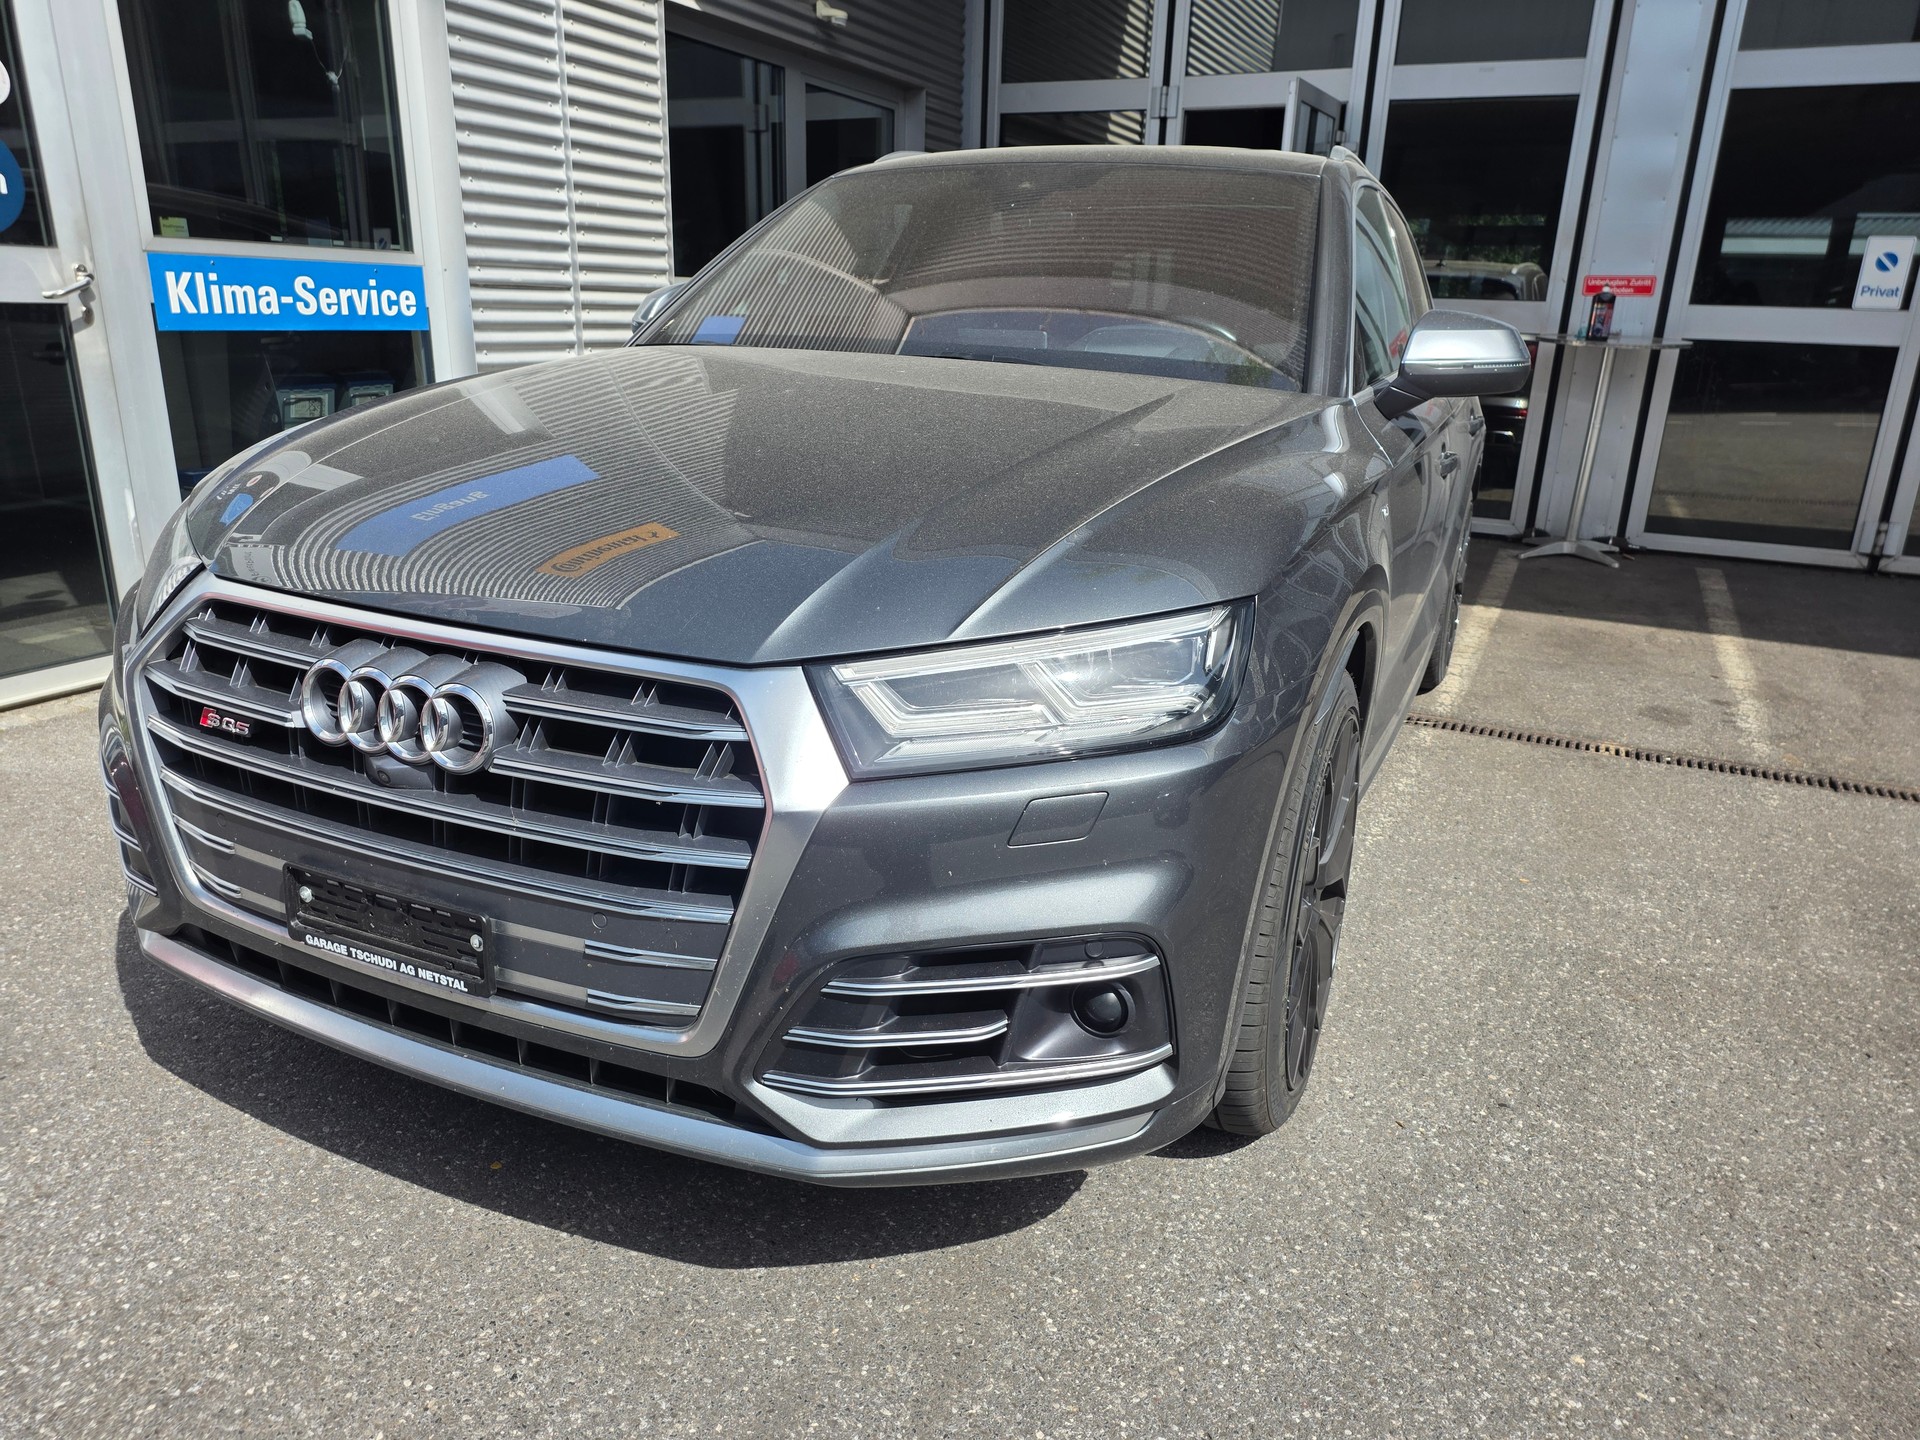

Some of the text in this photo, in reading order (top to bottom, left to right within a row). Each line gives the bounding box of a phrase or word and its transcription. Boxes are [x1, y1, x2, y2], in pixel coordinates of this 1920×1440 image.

[165, 271, 417, 317] Klima-Service
[1860, 285, 1900, 298] Privat
[201, 707, 250, 735] SQ5
[305, 934, 348, 956] GARAGE
[350, 947, 397, 971] TSCHUDI
[399, 965, 415, 976] AG
[418, 968, 468, 992] NETSTAL
